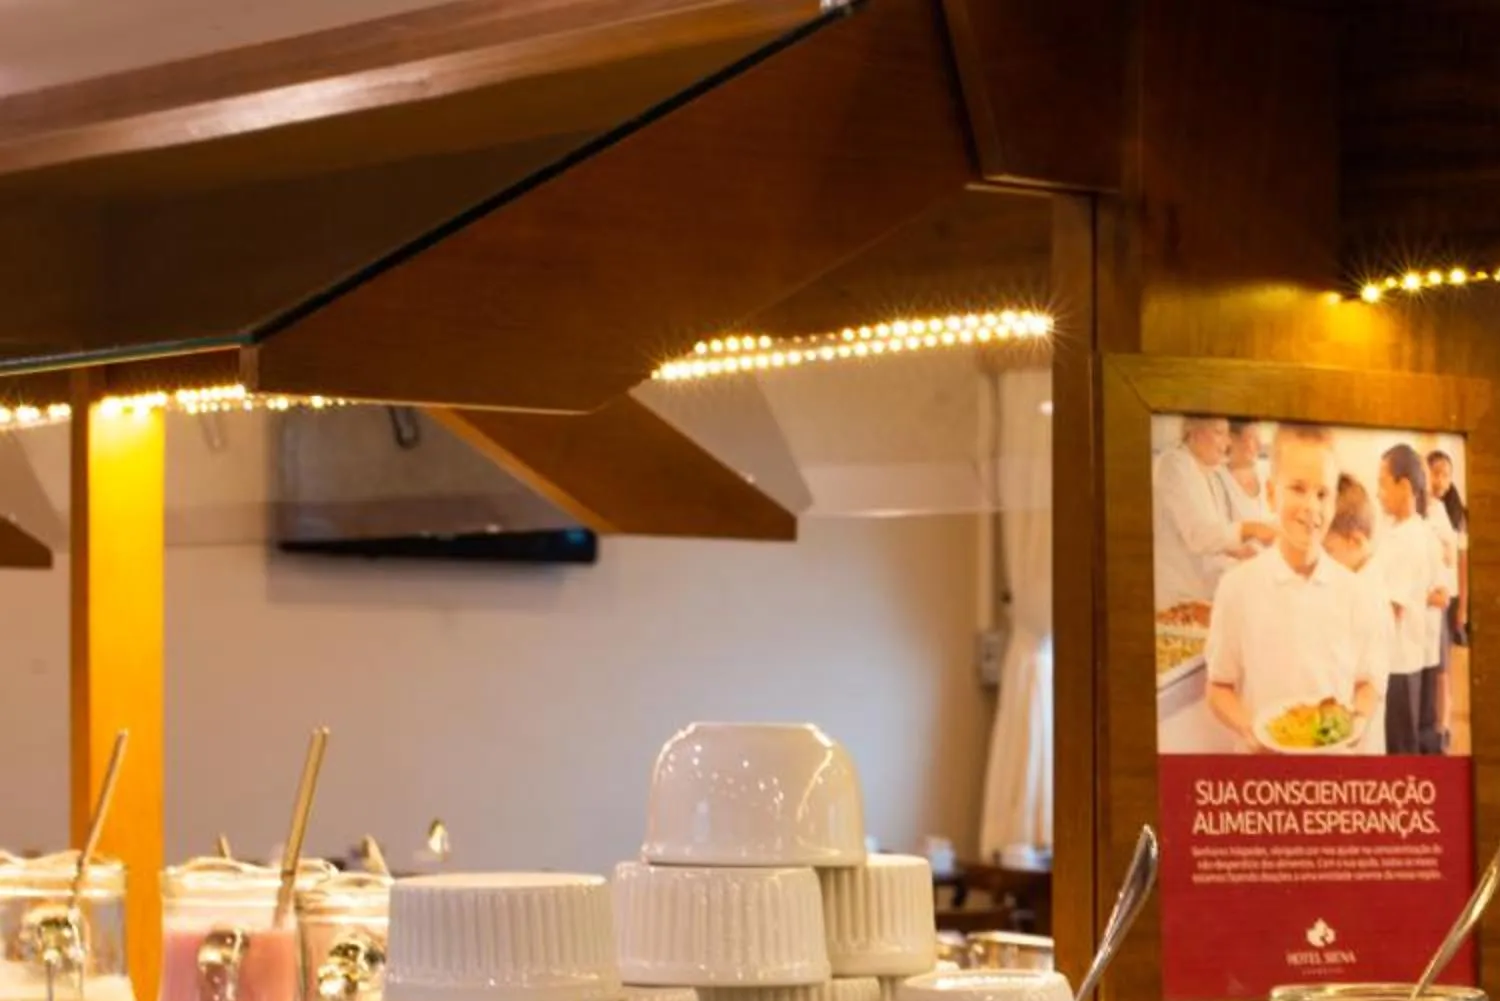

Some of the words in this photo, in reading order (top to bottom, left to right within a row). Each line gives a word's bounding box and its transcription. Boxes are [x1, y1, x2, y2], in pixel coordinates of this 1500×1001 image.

[1195, 780, 1238, 805] SUA
[1242, 775, 1436, 809] CONSCIENTIZAÇÃO
[1192, 810, 1299, 835] ALIMENTA
[1302, 810, 1440, 838] ESPERANÇAS.
